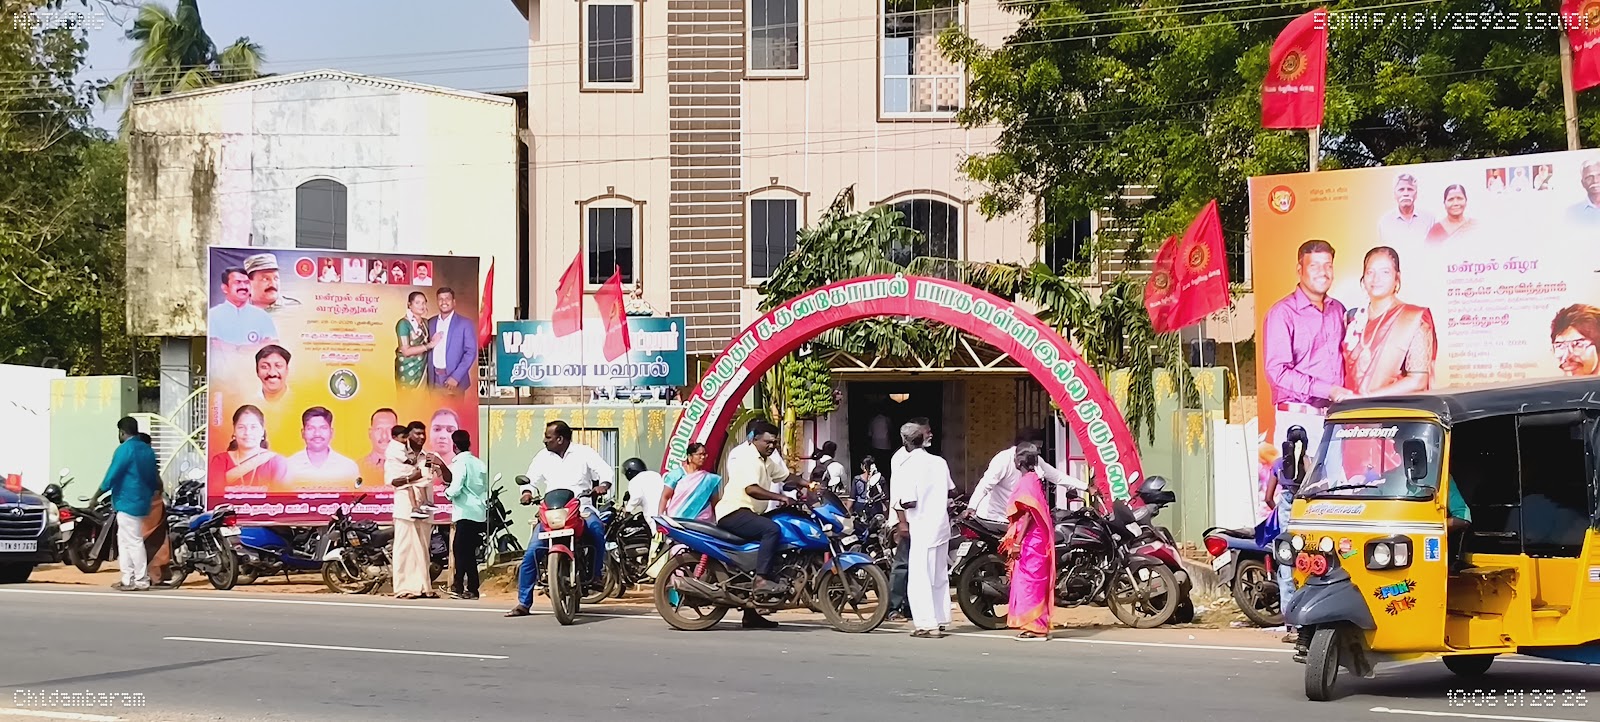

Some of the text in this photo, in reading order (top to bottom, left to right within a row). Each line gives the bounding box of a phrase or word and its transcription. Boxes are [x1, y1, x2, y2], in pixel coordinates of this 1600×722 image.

[1503, 256, 1539, 274] விழா
[510, 356, 670, 383] திருமண மஹால்
[701, 332, 759, 401] அமுதா
